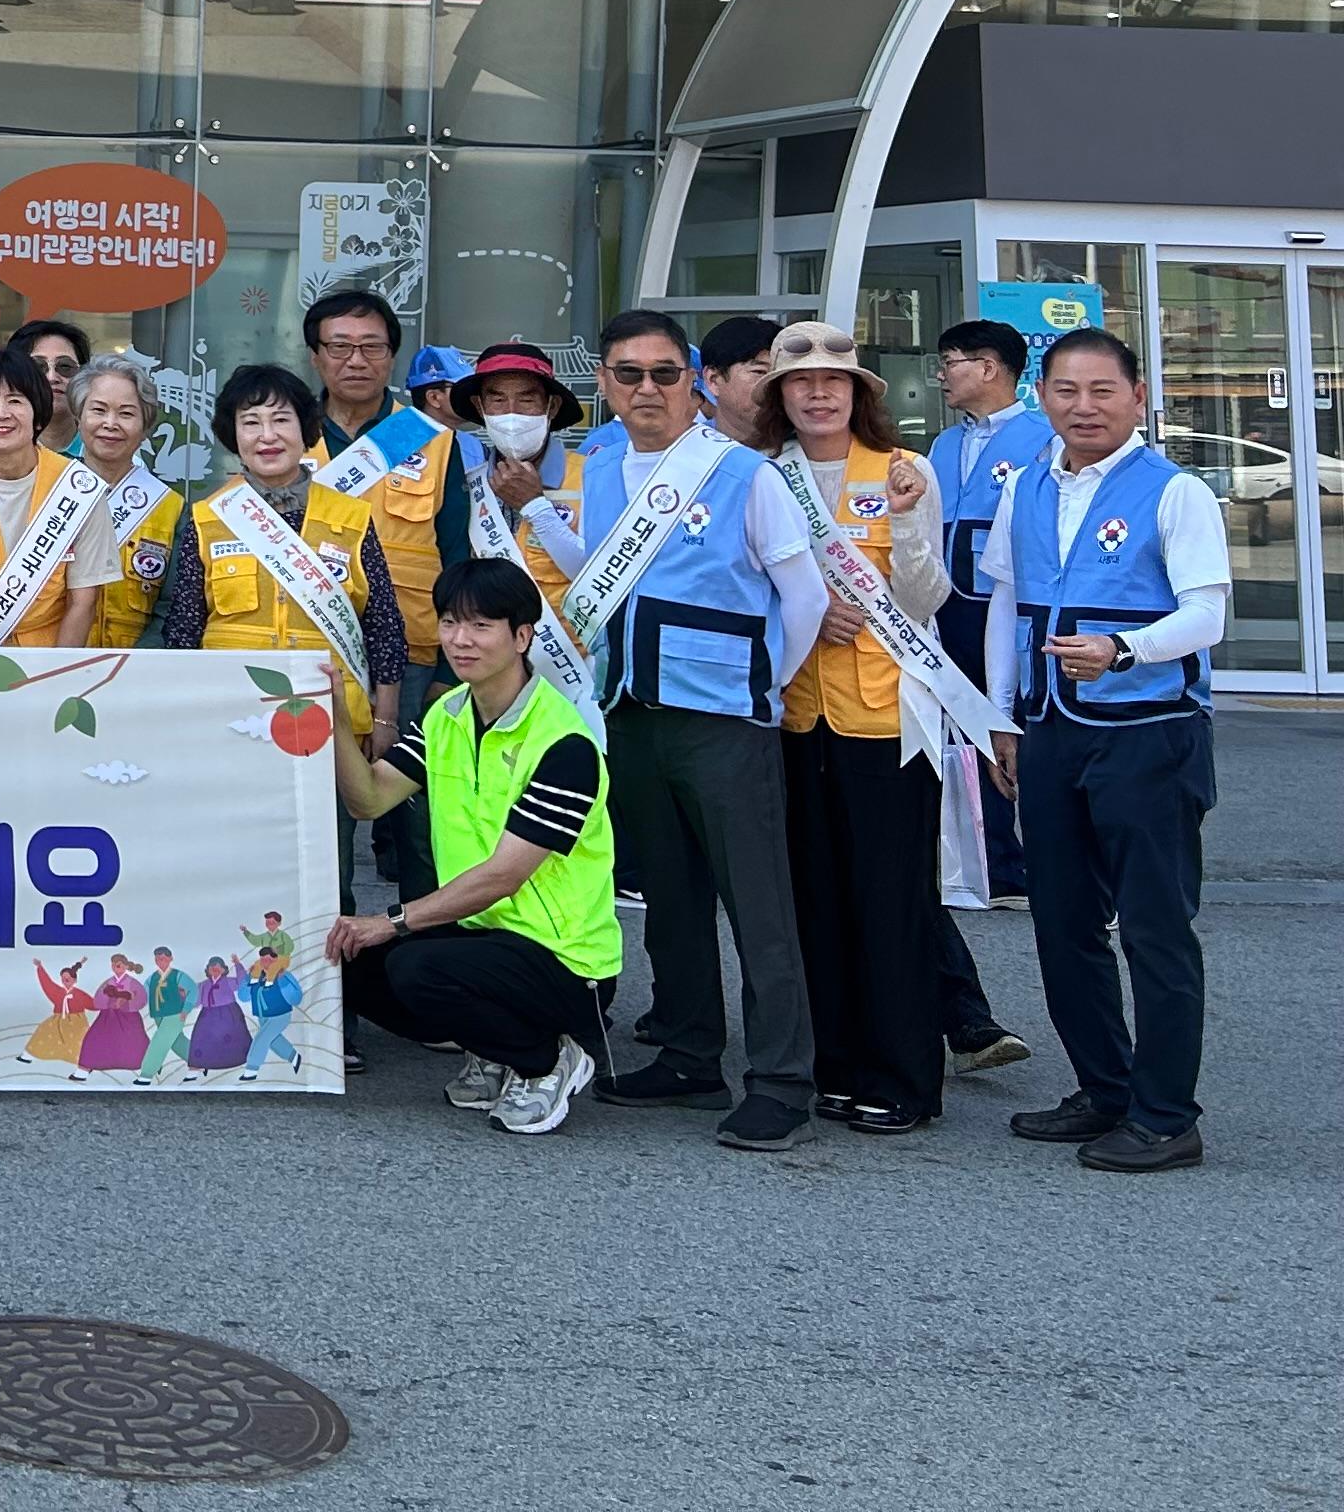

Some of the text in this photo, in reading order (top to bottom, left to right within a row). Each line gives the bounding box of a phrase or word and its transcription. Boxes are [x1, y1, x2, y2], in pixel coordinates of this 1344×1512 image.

[25, 199, 180, 232] 여행의 시작!
[22, 495, 79, 578] 대한민국
[240, 498, 286, 545] 사랑하는
[283, 543, 334, 595] 사람에게
[597, 516, 657, 600] 대한민국
[826, 540, 878, 593] 행복한
[875, 592, 943, 671] 실천입니다
